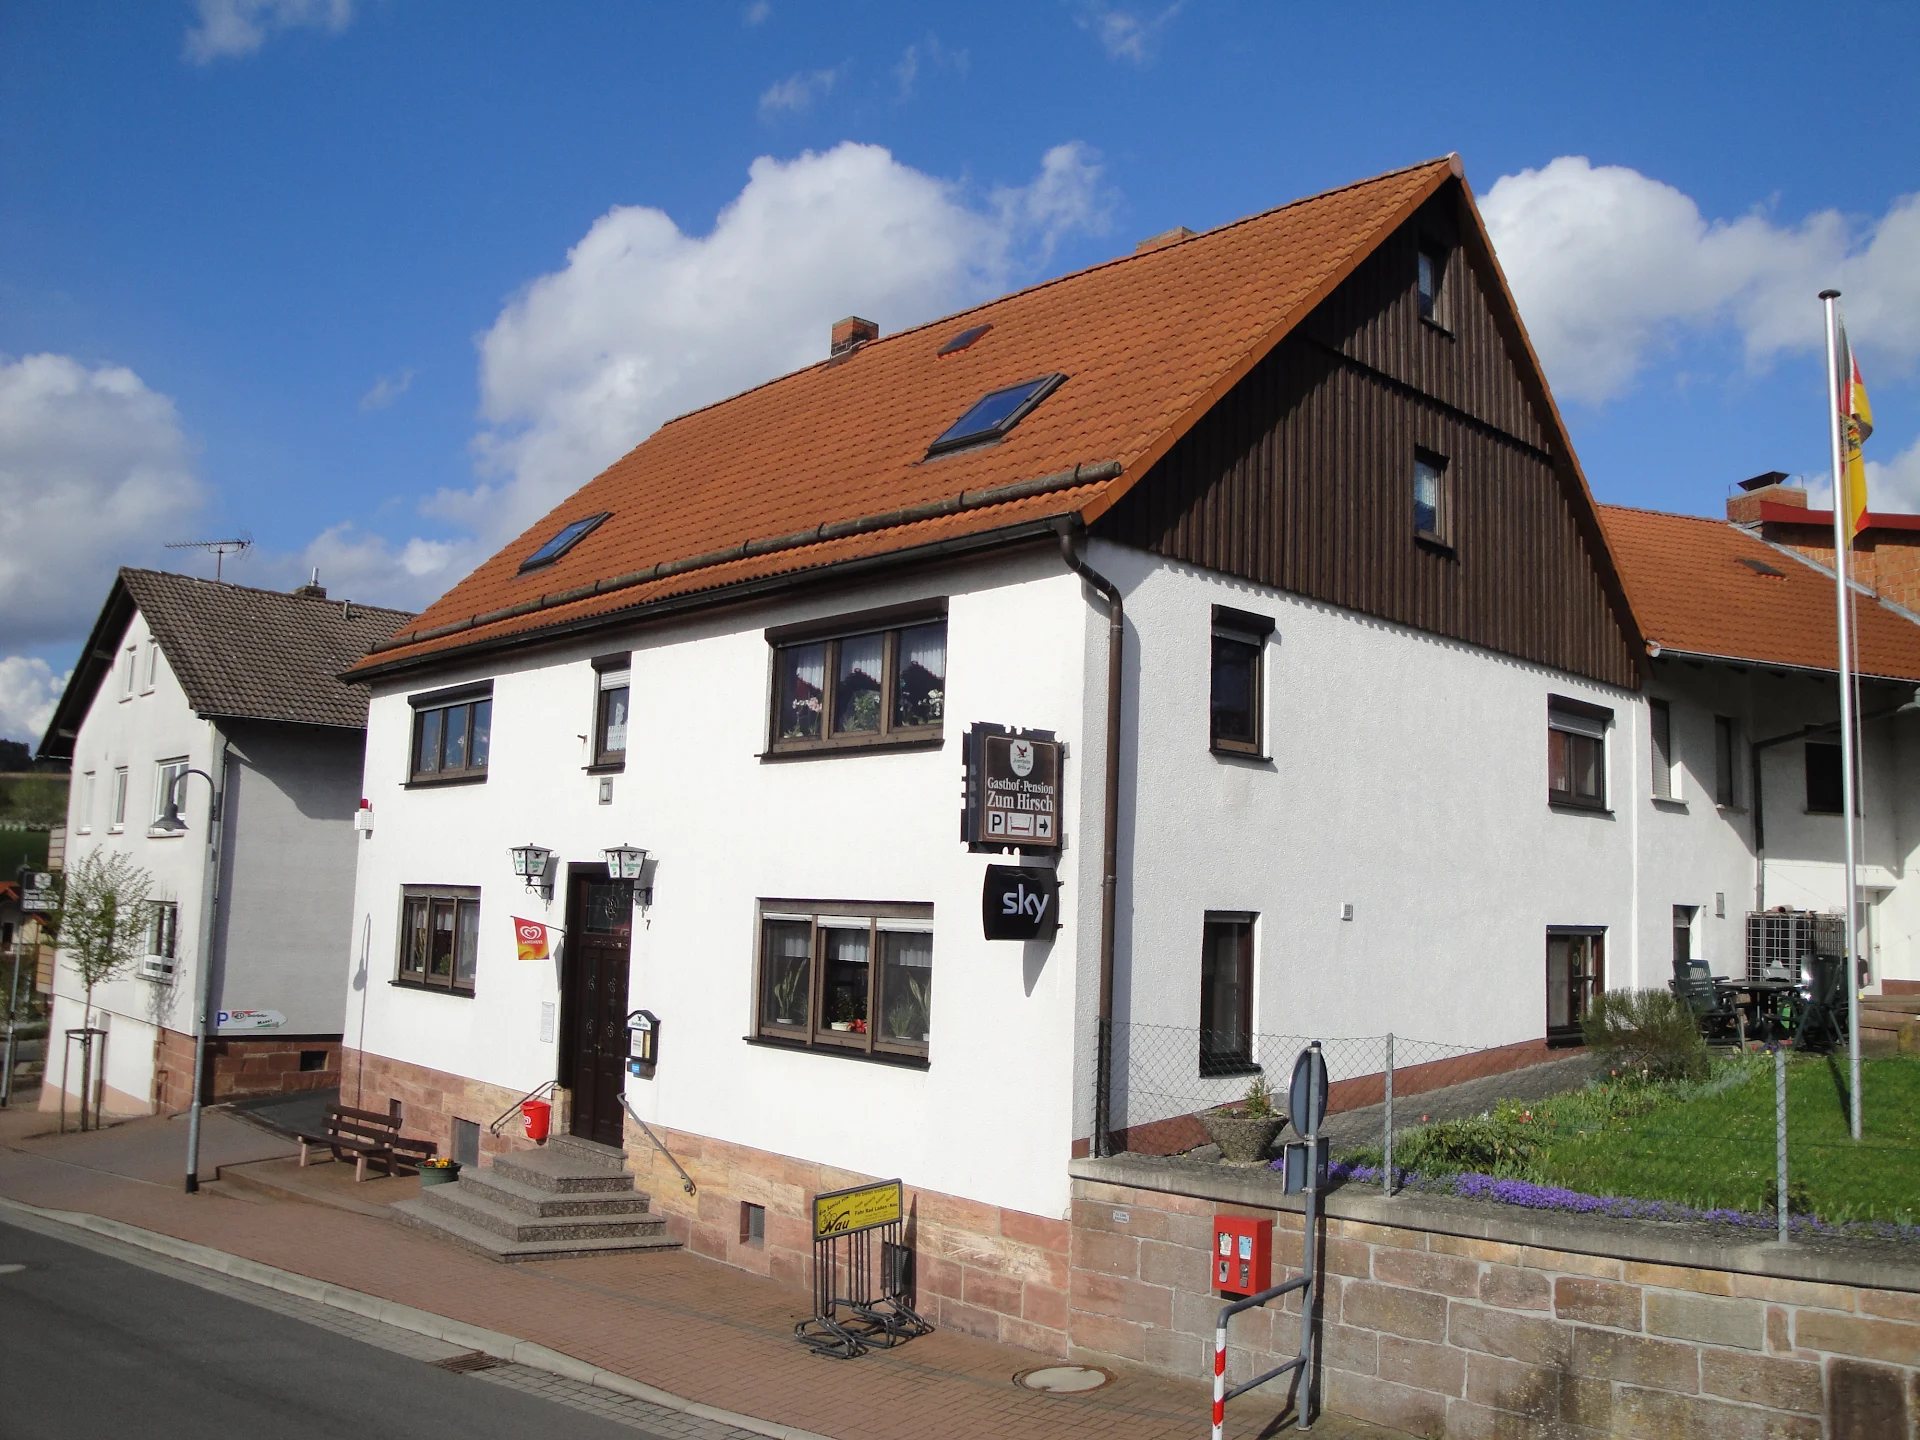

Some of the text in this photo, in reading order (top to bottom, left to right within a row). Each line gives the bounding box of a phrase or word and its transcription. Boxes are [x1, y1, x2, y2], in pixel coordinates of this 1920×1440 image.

[987, 790, 1054, 812] Zum Hirsch
[991, 813, 1002, 832] P
[1002, 883, 1050, 924] sky
[646, 919, 651, 931] 7
[216, 1012, 229, 1027] P
[820, 1210, 850, 1235] Nau
